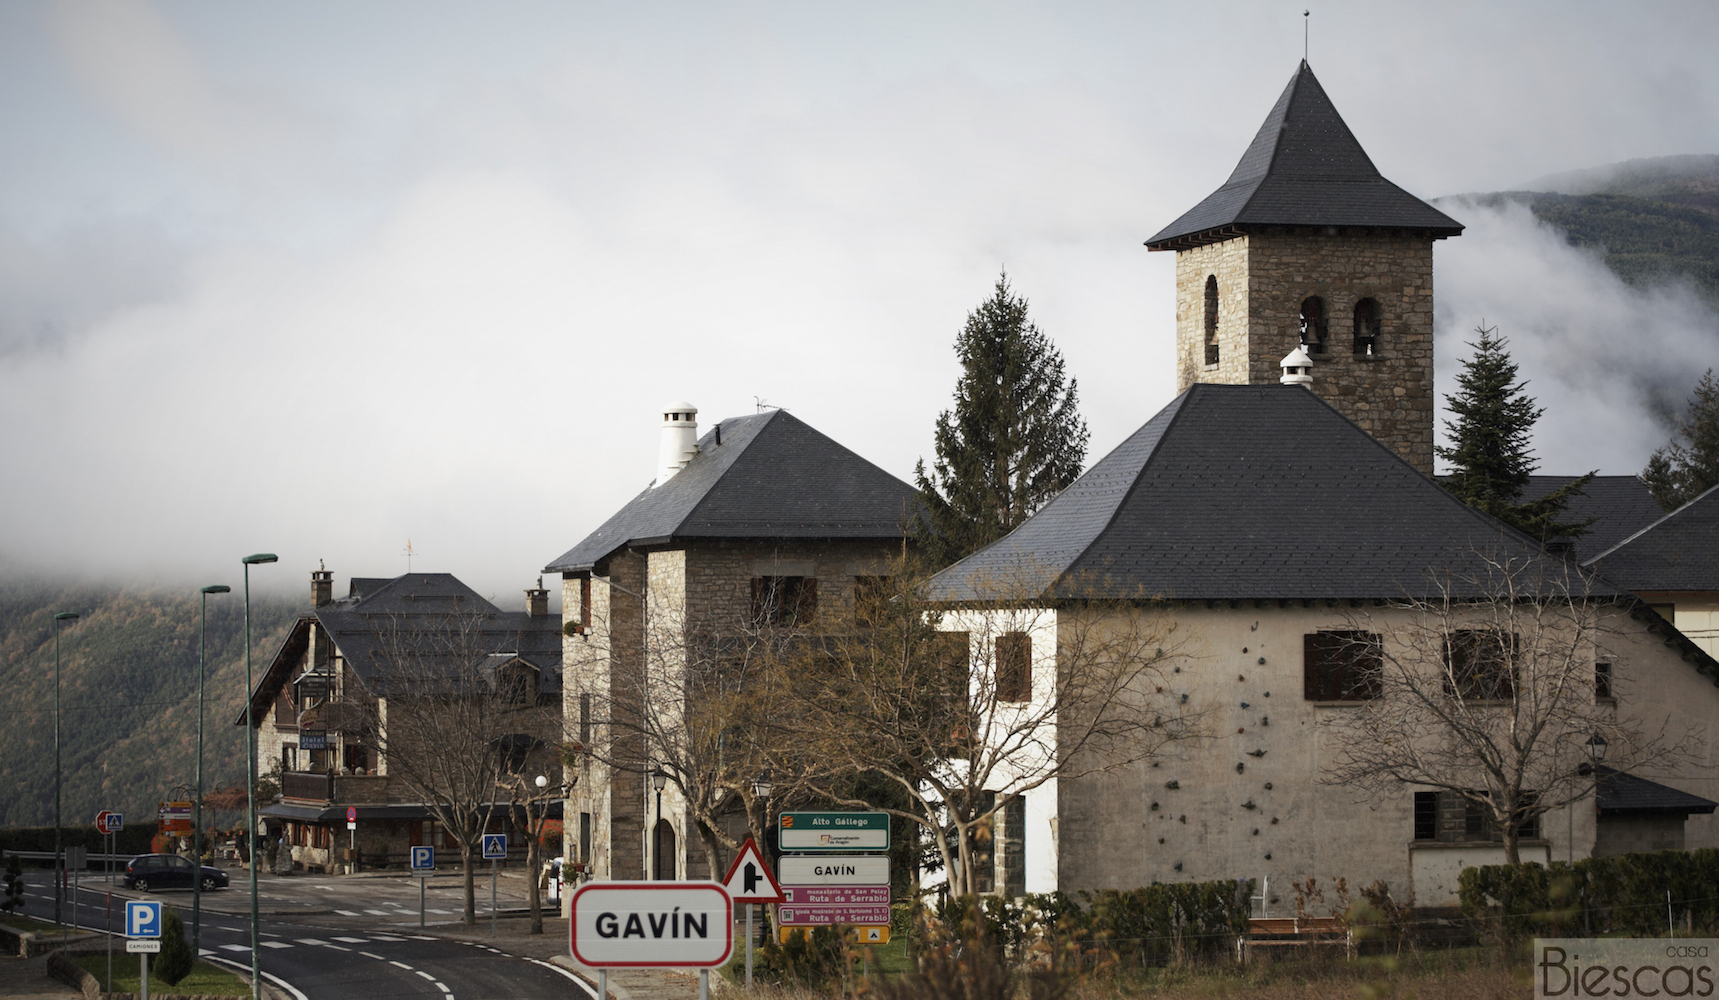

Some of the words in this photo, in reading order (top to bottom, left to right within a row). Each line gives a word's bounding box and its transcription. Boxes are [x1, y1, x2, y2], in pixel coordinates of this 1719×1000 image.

[835, 818, 868, 826] Gállego
[416, 849, 430, 866] P
[814, 864, 855, 875] GAVÍN
[132, 904, 154, 933] P
[596, 906, 708, 939] GAVÍN
[809, 914, 829, 922] Ruta
[834, 914, 845, 922] de
[851, 914, 888, 922] Serrablo
